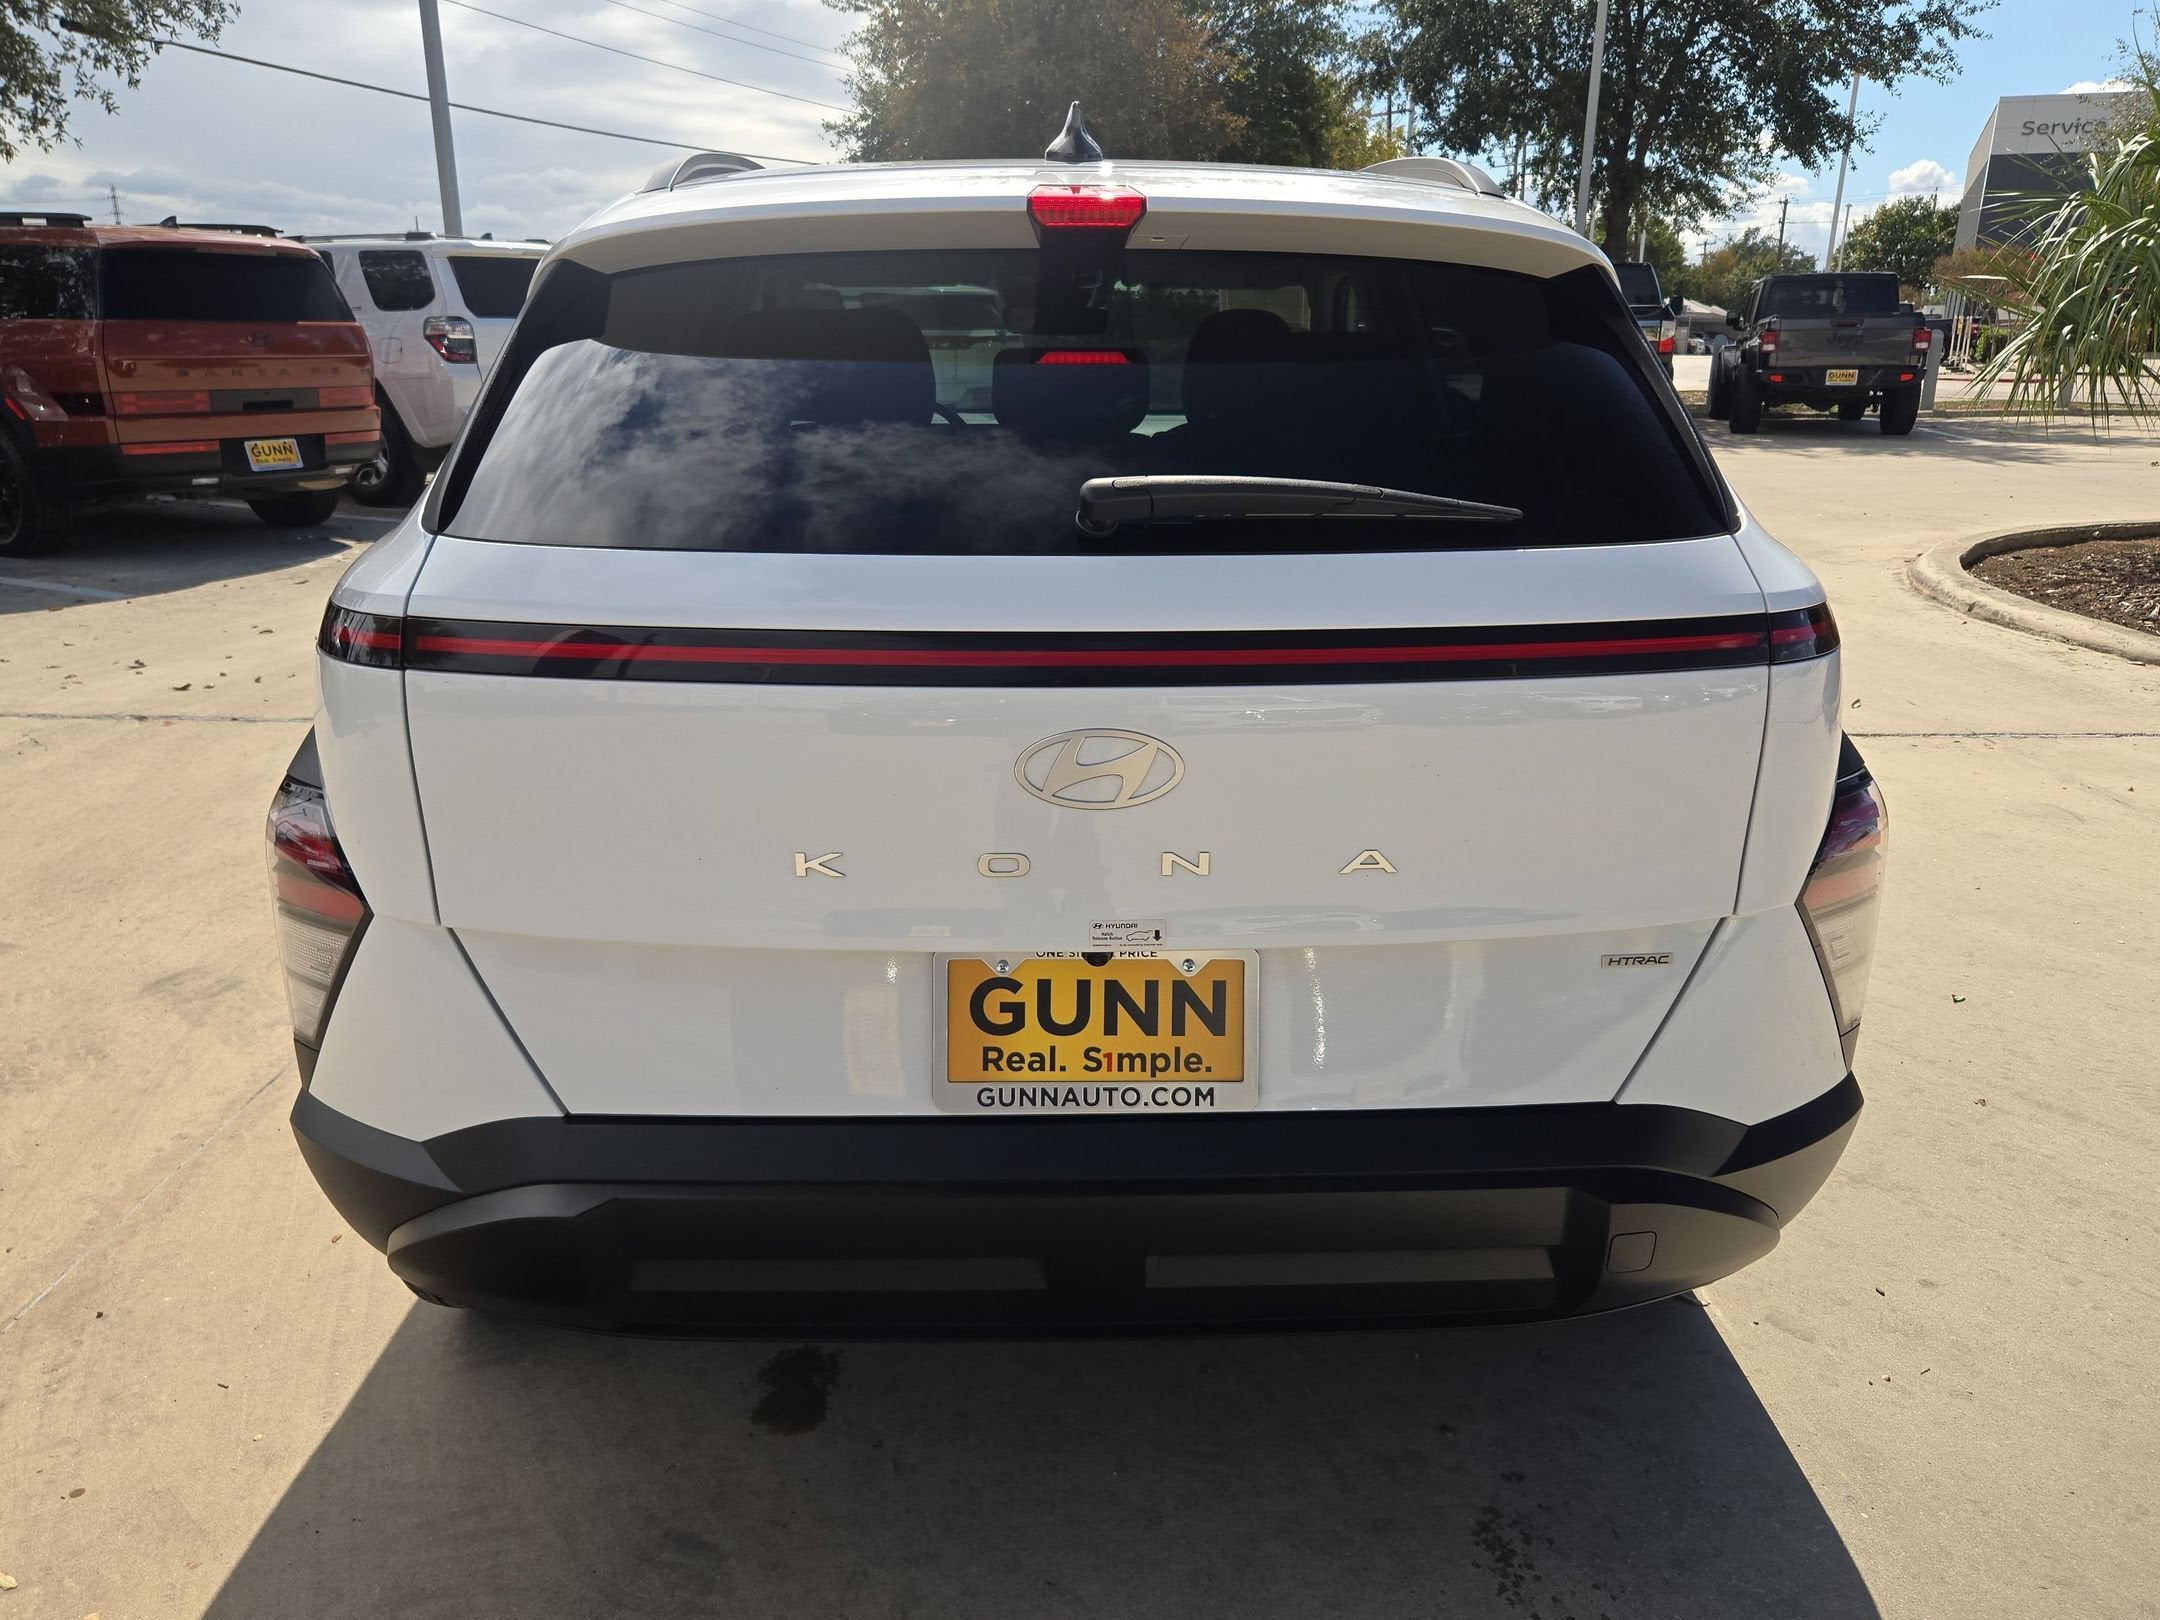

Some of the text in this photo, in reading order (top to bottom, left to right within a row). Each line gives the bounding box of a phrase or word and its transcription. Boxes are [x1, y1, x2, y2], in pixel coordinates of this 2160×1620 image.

[251, 444, 294, 458] GUNN
[1608, 955, 1670, 966] HTRAC
[969, 976, 1227, 1037] GUNN
[982, 1046, 1066, 1073] Real.
[976, 1086, 1215, 1108] GUNNAUTO.COM
